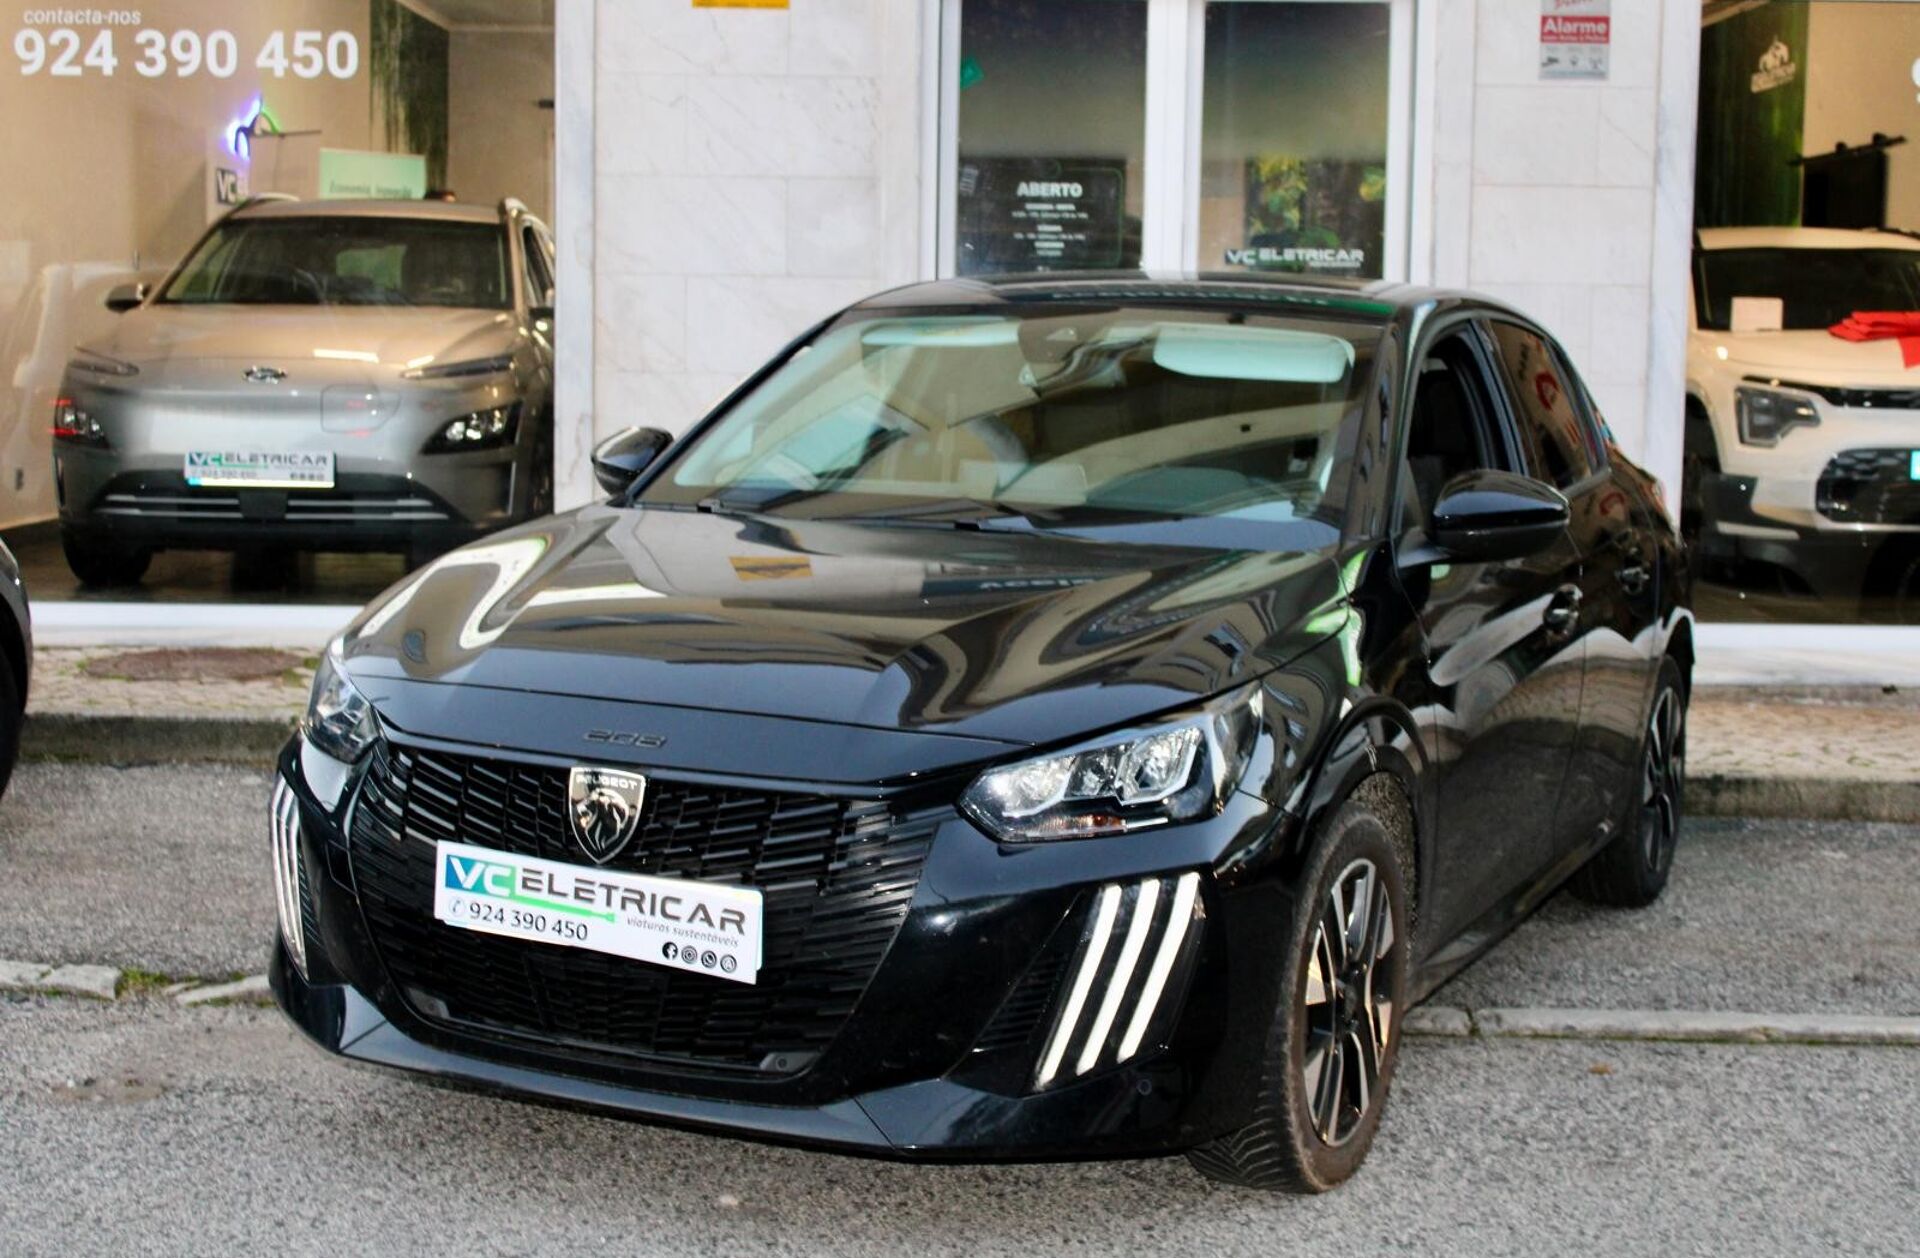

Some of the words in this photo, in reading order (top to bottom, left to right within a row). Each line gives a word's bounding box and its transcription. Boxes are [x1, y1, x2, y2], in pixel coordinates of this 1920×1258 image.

[23, 9, 141, 25] contacta-nos
[1544, 18, 1607, 33] Alarme
[13, 28, 119, 76] 924
[134, 29, 238, 78] 390
[255, 30, 359, 79] 450
[1016, 181, 1083, 198] ABERTO
[469, 902, 505, 924] 924
[511, 908, 547, 932] 390
[551, 920, 588, 941] 450
